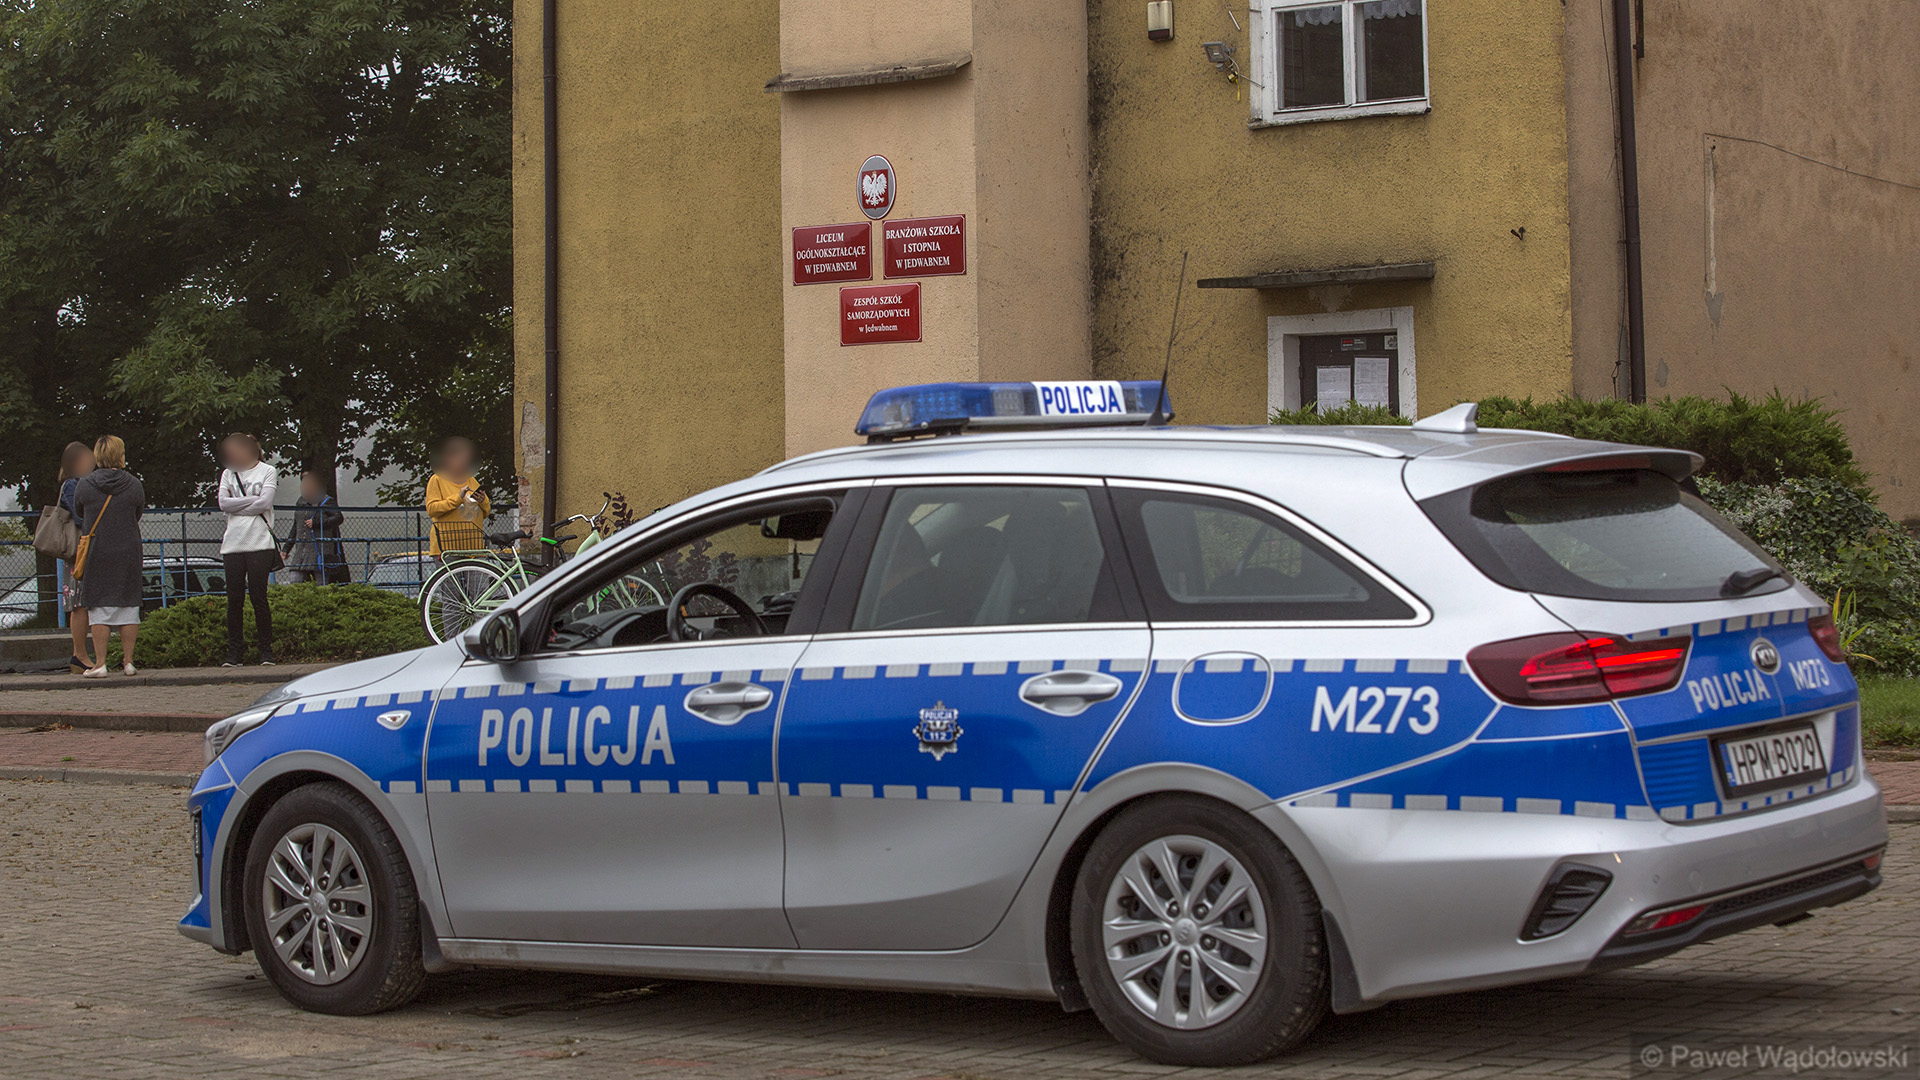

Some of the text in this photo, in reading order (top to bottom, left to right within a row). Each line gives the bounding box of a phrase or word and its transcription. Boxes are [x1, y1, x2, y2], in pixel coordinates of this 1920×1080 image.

[816, 232, 844, 243] LICEUM
[886, 225, 961, 240] BRANŻOWA SZKOŁA
[796, 245, 866, 260] OGÓLNOKSZTAŁCĄCE
[903, 241, 941, 253] I STOPNIA
[805, 261, 857, 275] W JEDWABNEM
[895, 256, 950, 270] W JEDWABNEM
[853, 293, 903, 307] ZESPÓŁ SZKÓŁ
[847, 308, 910, 320] SAMORZĄDOWYCH
[865, 323, 898, 334] Jedwabnem
[1041, 385, 1122, 414] POLICJA
[1686, 658, 1830, 713] POLICJA M273
[1310, 685, 1440, 735] M273
[478, 705, 676, 767] POLICJA
[929, 731, 947, 741] 112
